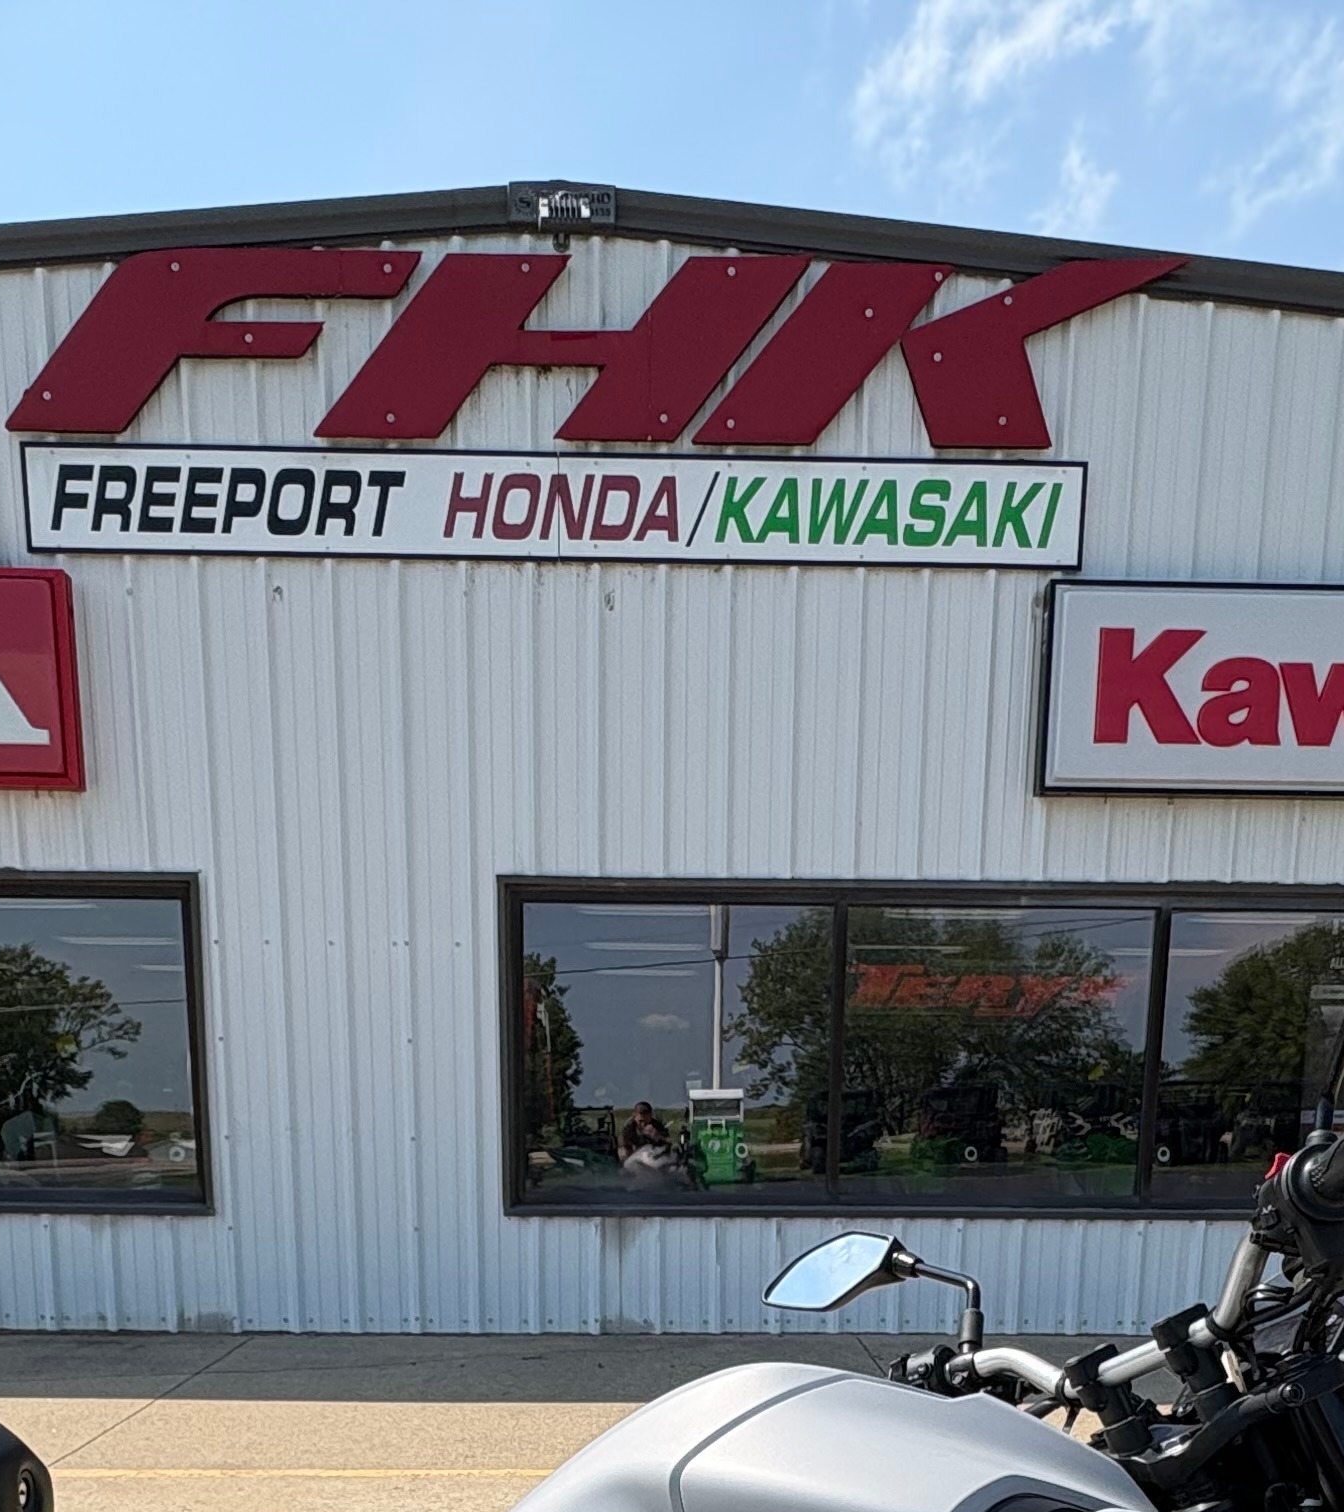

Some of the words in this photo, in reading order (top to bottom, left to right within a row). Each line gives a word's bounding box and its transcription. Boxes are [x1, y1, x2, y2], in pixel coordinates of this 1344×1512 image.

[6, 247, 1188, 449] FHK
[50, 463, 407, 537] FREEPORT
[442, 472, 1063, 550] HONDA/KAWASAKI
